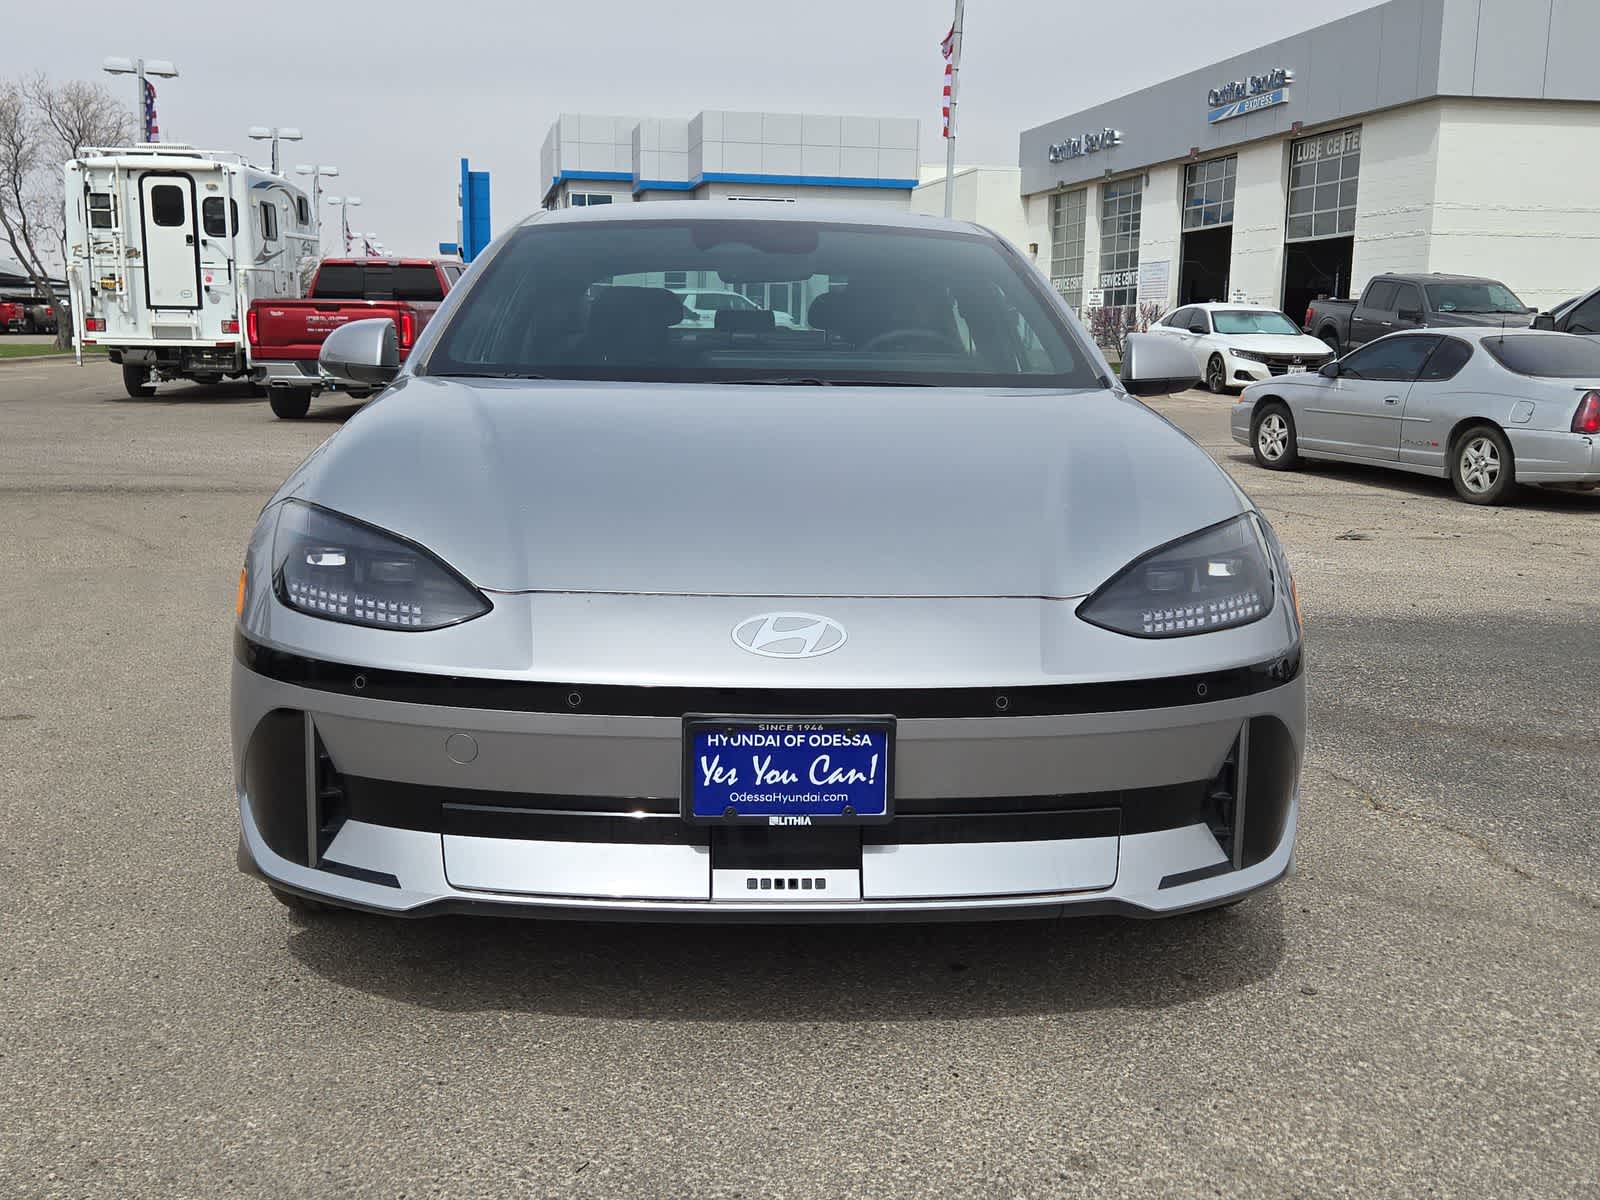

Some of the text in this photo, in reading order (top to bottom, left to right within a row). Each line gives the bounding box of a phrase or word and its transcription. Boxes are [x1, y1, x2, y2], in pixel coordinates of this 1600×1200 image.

[1208, 68, 1296, 107] Certified Service
[1244, 94, 1273, 111] express
[1297, 137, 1322, 162] LUBE
[1101, 272, 1121, 288] SERVICE
[758, 724, 793, 732] SINCE
[707, 734, 872, 747] HYUNDAI OF ODESSA
[700, 753, 878, 786] Yes You Can!
[729, 791, 848, 804] OdessaHyundai.com
[779, 816, 812, 826] LITHIA
